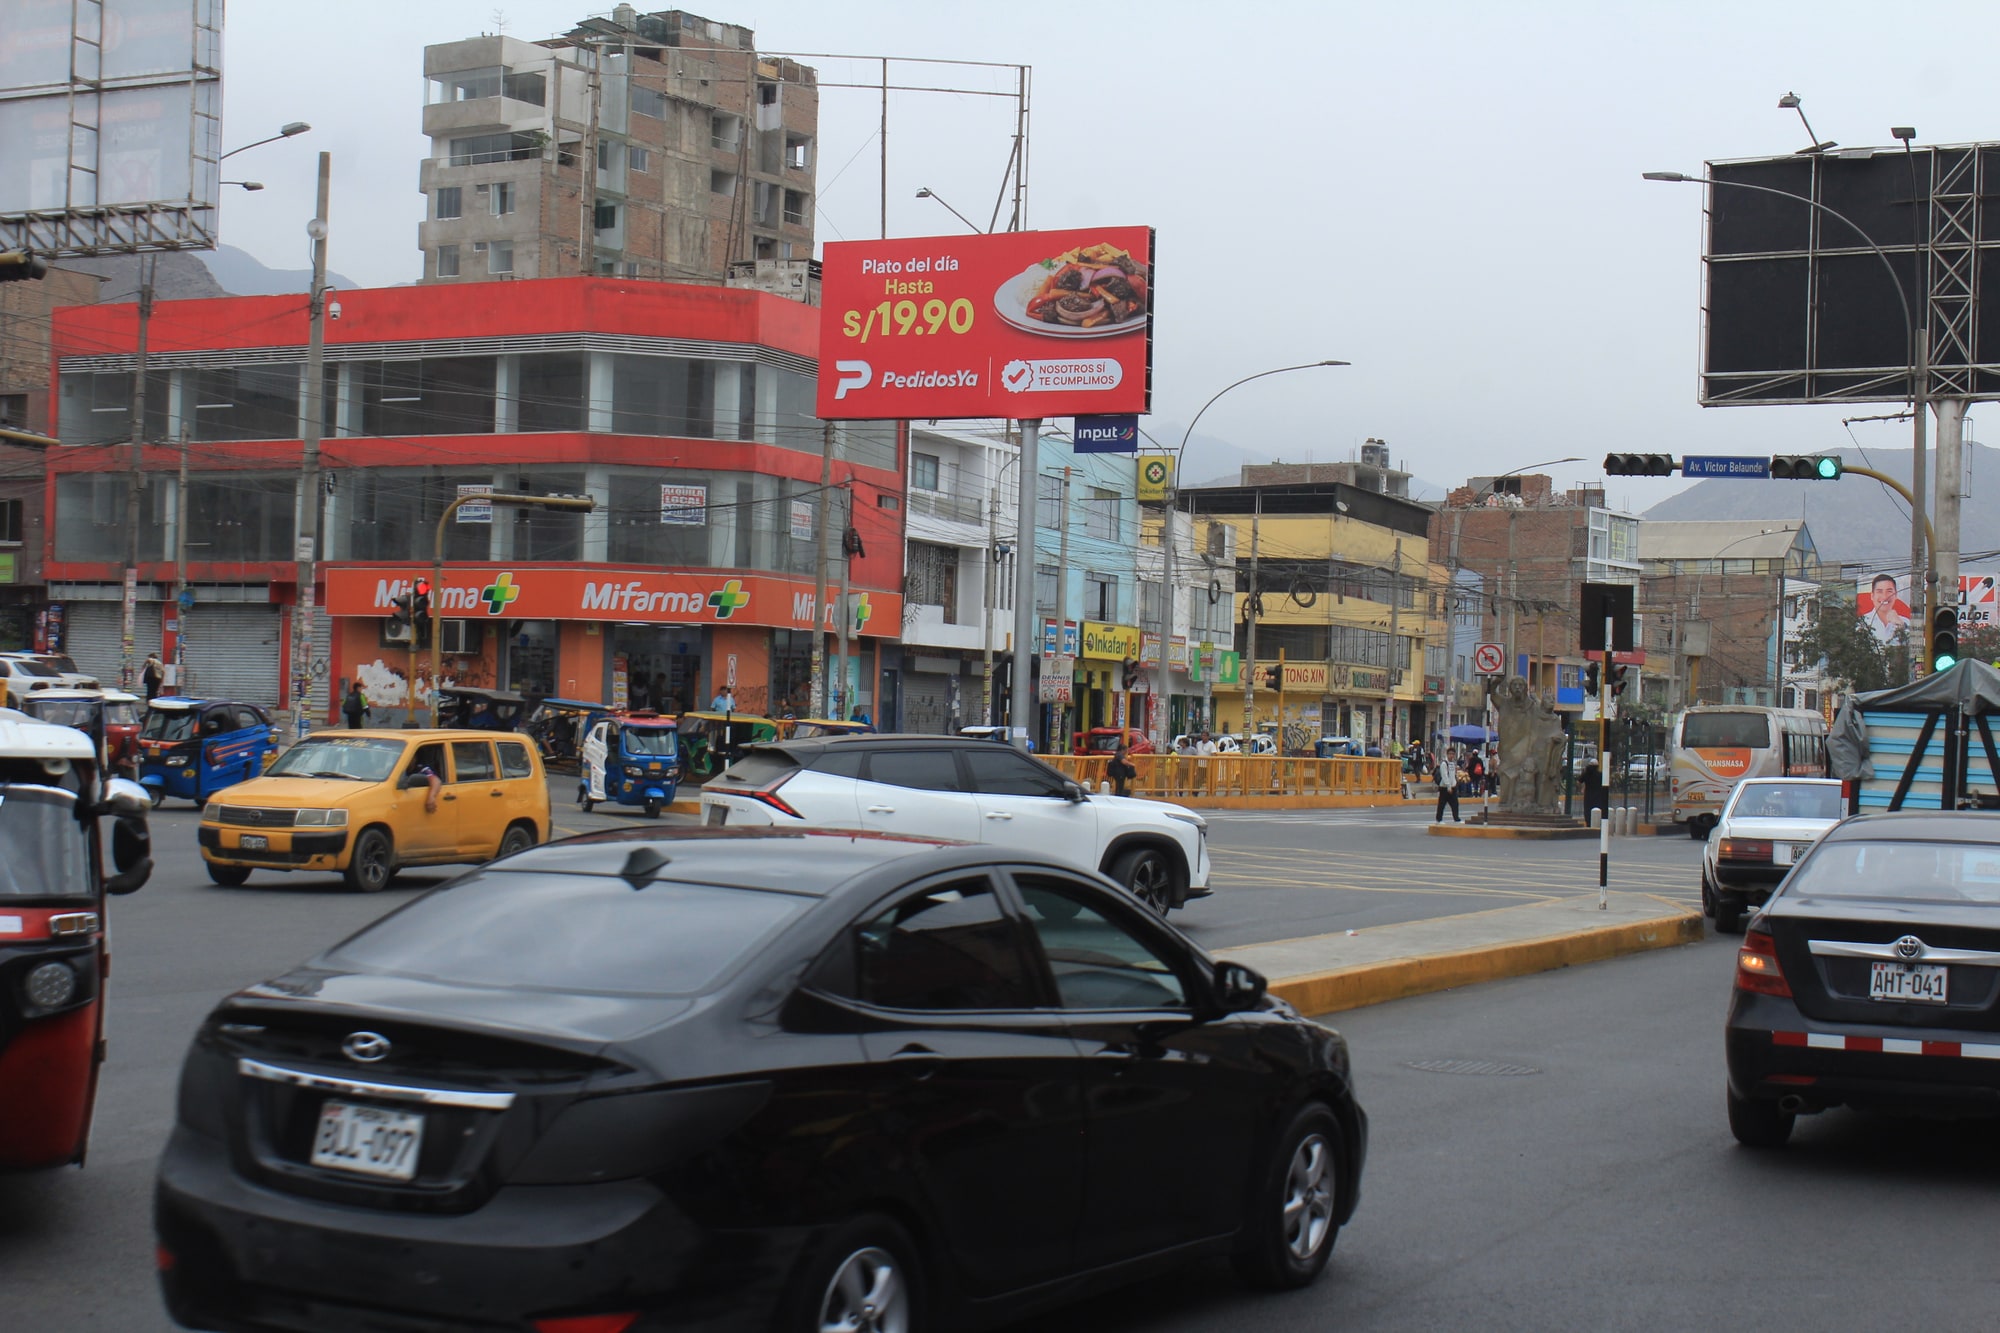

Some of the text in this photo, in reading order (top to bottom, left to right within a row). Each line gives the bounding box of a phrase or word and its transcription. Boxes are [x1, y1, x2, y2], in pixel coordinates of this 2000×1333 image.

[862, 255, 959, 274] Plato del día
[885, 279, 933, 295] Hasta
[843, 298, 974, 343] S/19.90
[1039, 361, 1106, 374] NOSOTROS SÍ
[881, 369, 978, 388] PedidosYa
[1039, 374, 1115, 386] TE CUMPLIMOS
[1078, 426, 1118, 441] input
[1689, 462, 1763, 473] Av. Victor Belaunde
[664, 495, 701, 505] LOCAL
[374, 579, 479, 609] Mima
[581, 582, 704, 614] Mifarma
[1285, 668, 1308, 683] TONG
[1310, 668, 1325, 683] XIN
[1057, 688, 1069, 701] 25
[1704, 759, 1744, 768] TRANSNASA
[1873, 971, 1943, 996] AHT-041
